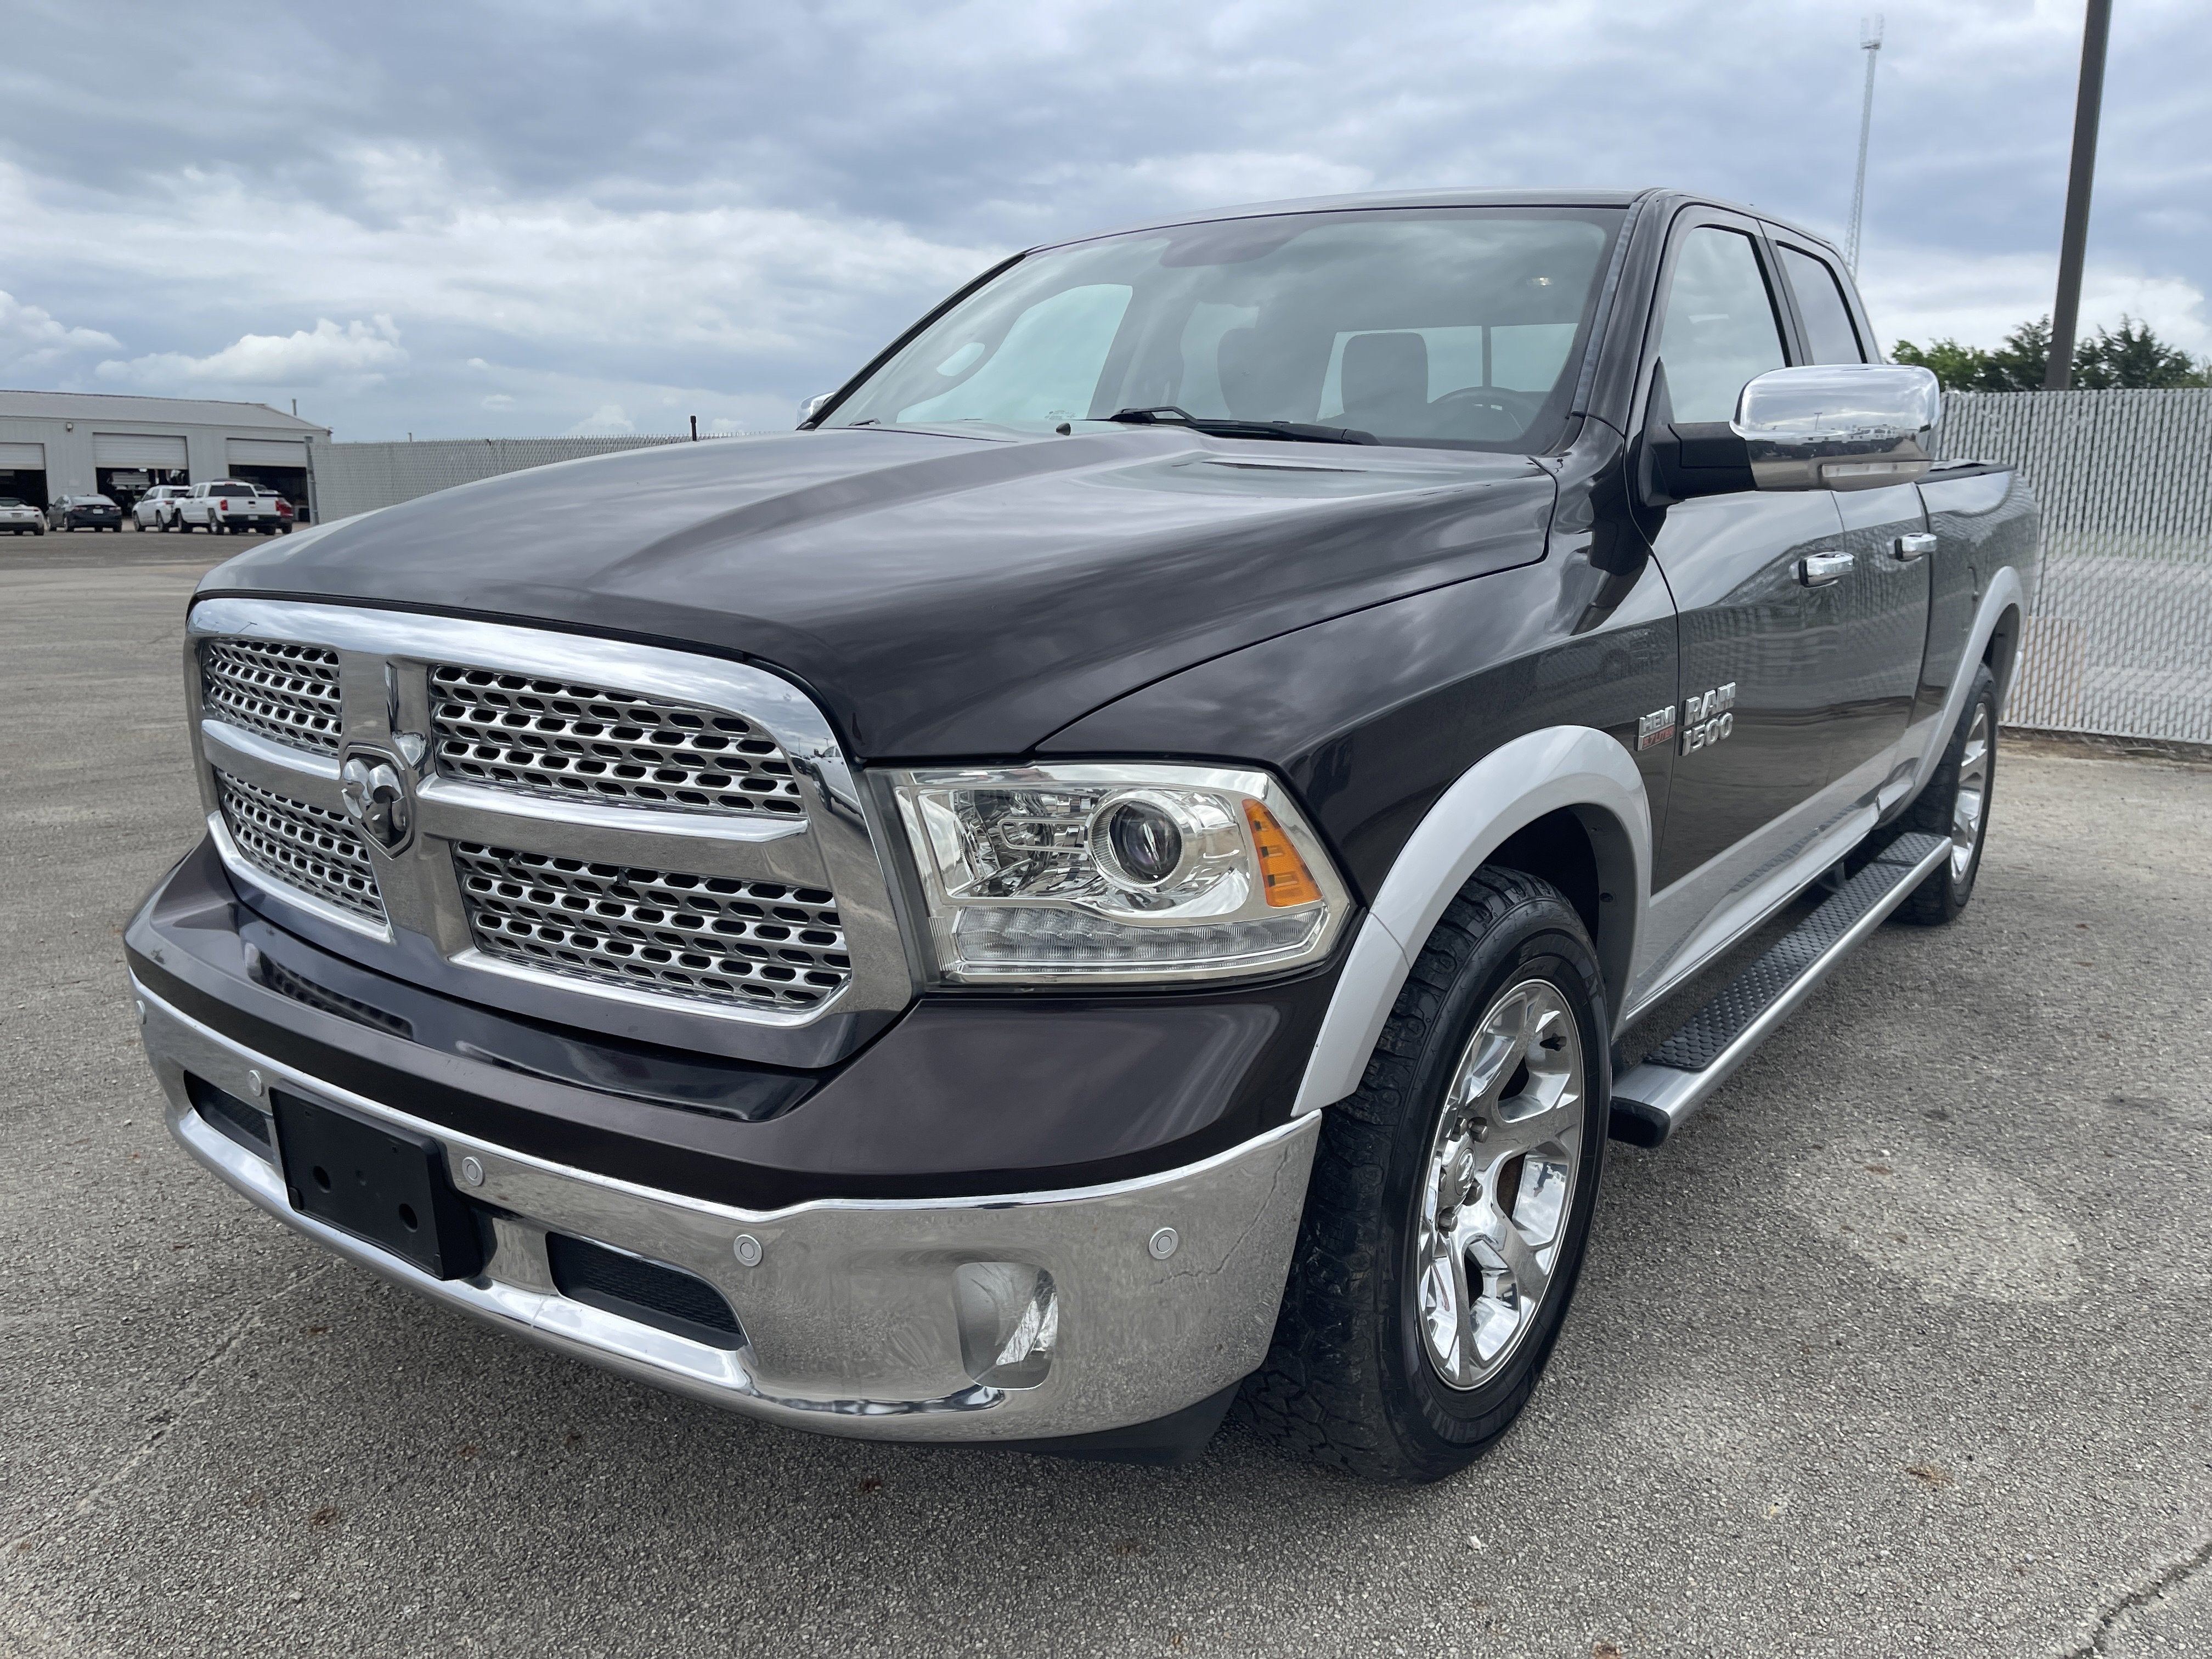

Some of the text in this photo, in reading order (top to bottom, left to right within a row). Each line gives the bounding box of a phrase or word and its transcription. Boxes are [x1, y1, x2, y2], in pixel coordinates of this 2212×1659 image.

[1639, 706, 1675, 734] HEMI
[1684, 682, 1736, 726] RAM
[1682, 712, 1733, 756] 1500
